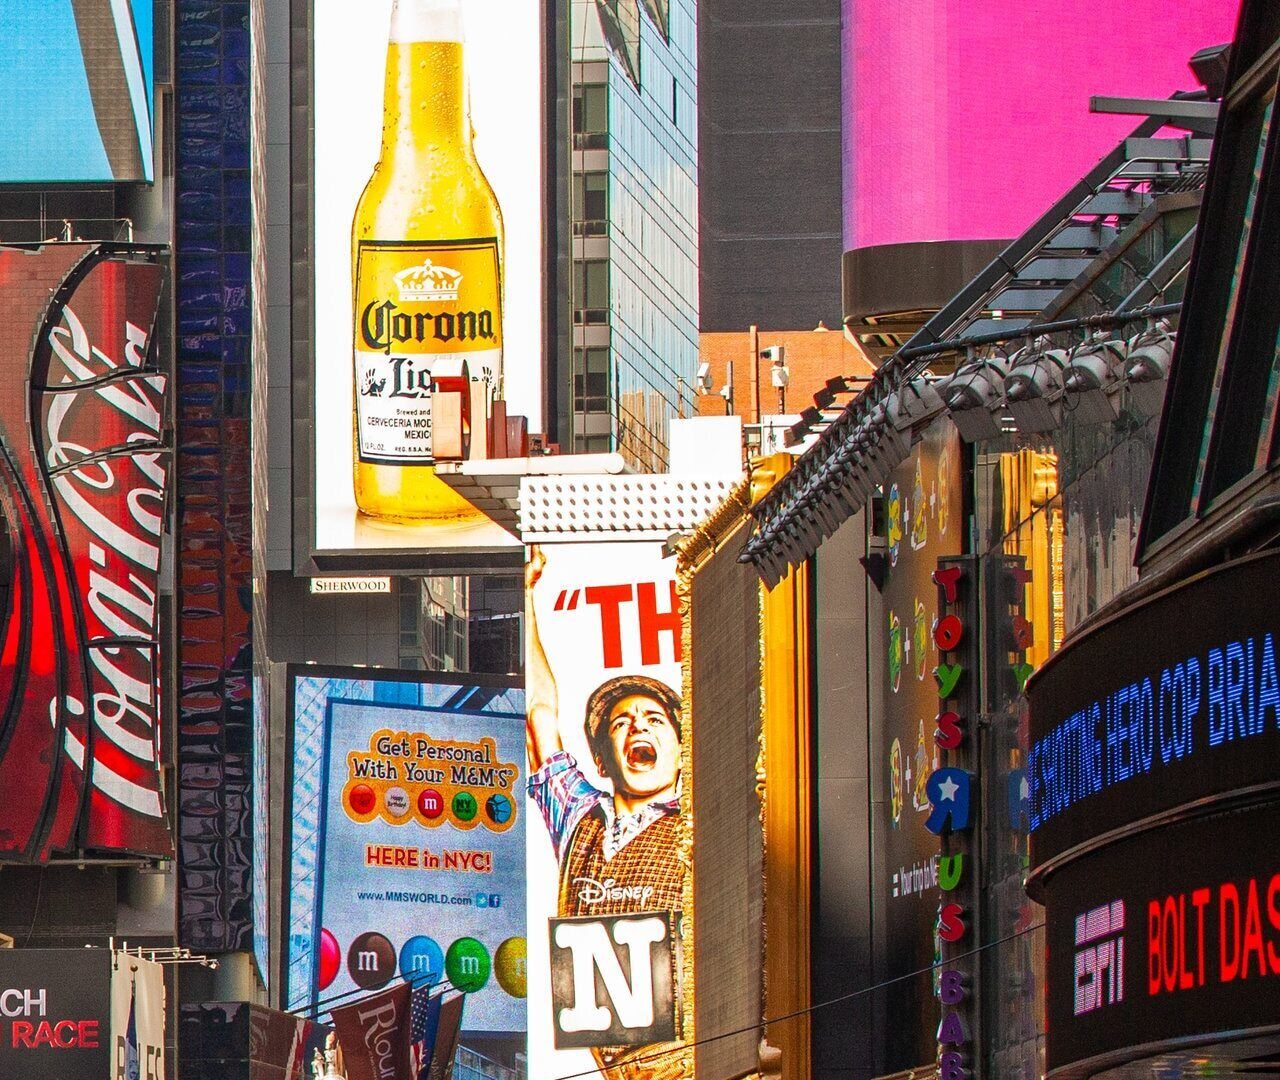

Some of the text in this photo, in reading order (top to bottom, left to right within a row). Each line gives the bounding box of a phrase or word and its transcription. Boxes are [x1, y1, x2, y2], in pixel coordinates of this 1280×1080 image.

[361, 300, 496, 355] Corona
[367, 418, 412, 429] CERVECERIA
[396, 408, 431, 416] Brewed and
[315, 578, 386, 591] SHERWOOD
[1107, 676, 1153, 786] HERO
[1159, 656, 1201, 766] COP
[377, 736, 491, 765] Get Personal
[353, 758, 445, 785] With Your
[366, 844, 492, 874] HERE in NYC!
[357, 889, 473, 907] www.MMSWORLD.com
[577, 877, 654, 904] Disney
[1149, 886, 1211, 996] BOLT
[358, 949, 480, 975] m m m
[12, 1019, 100, 1049] RACE
